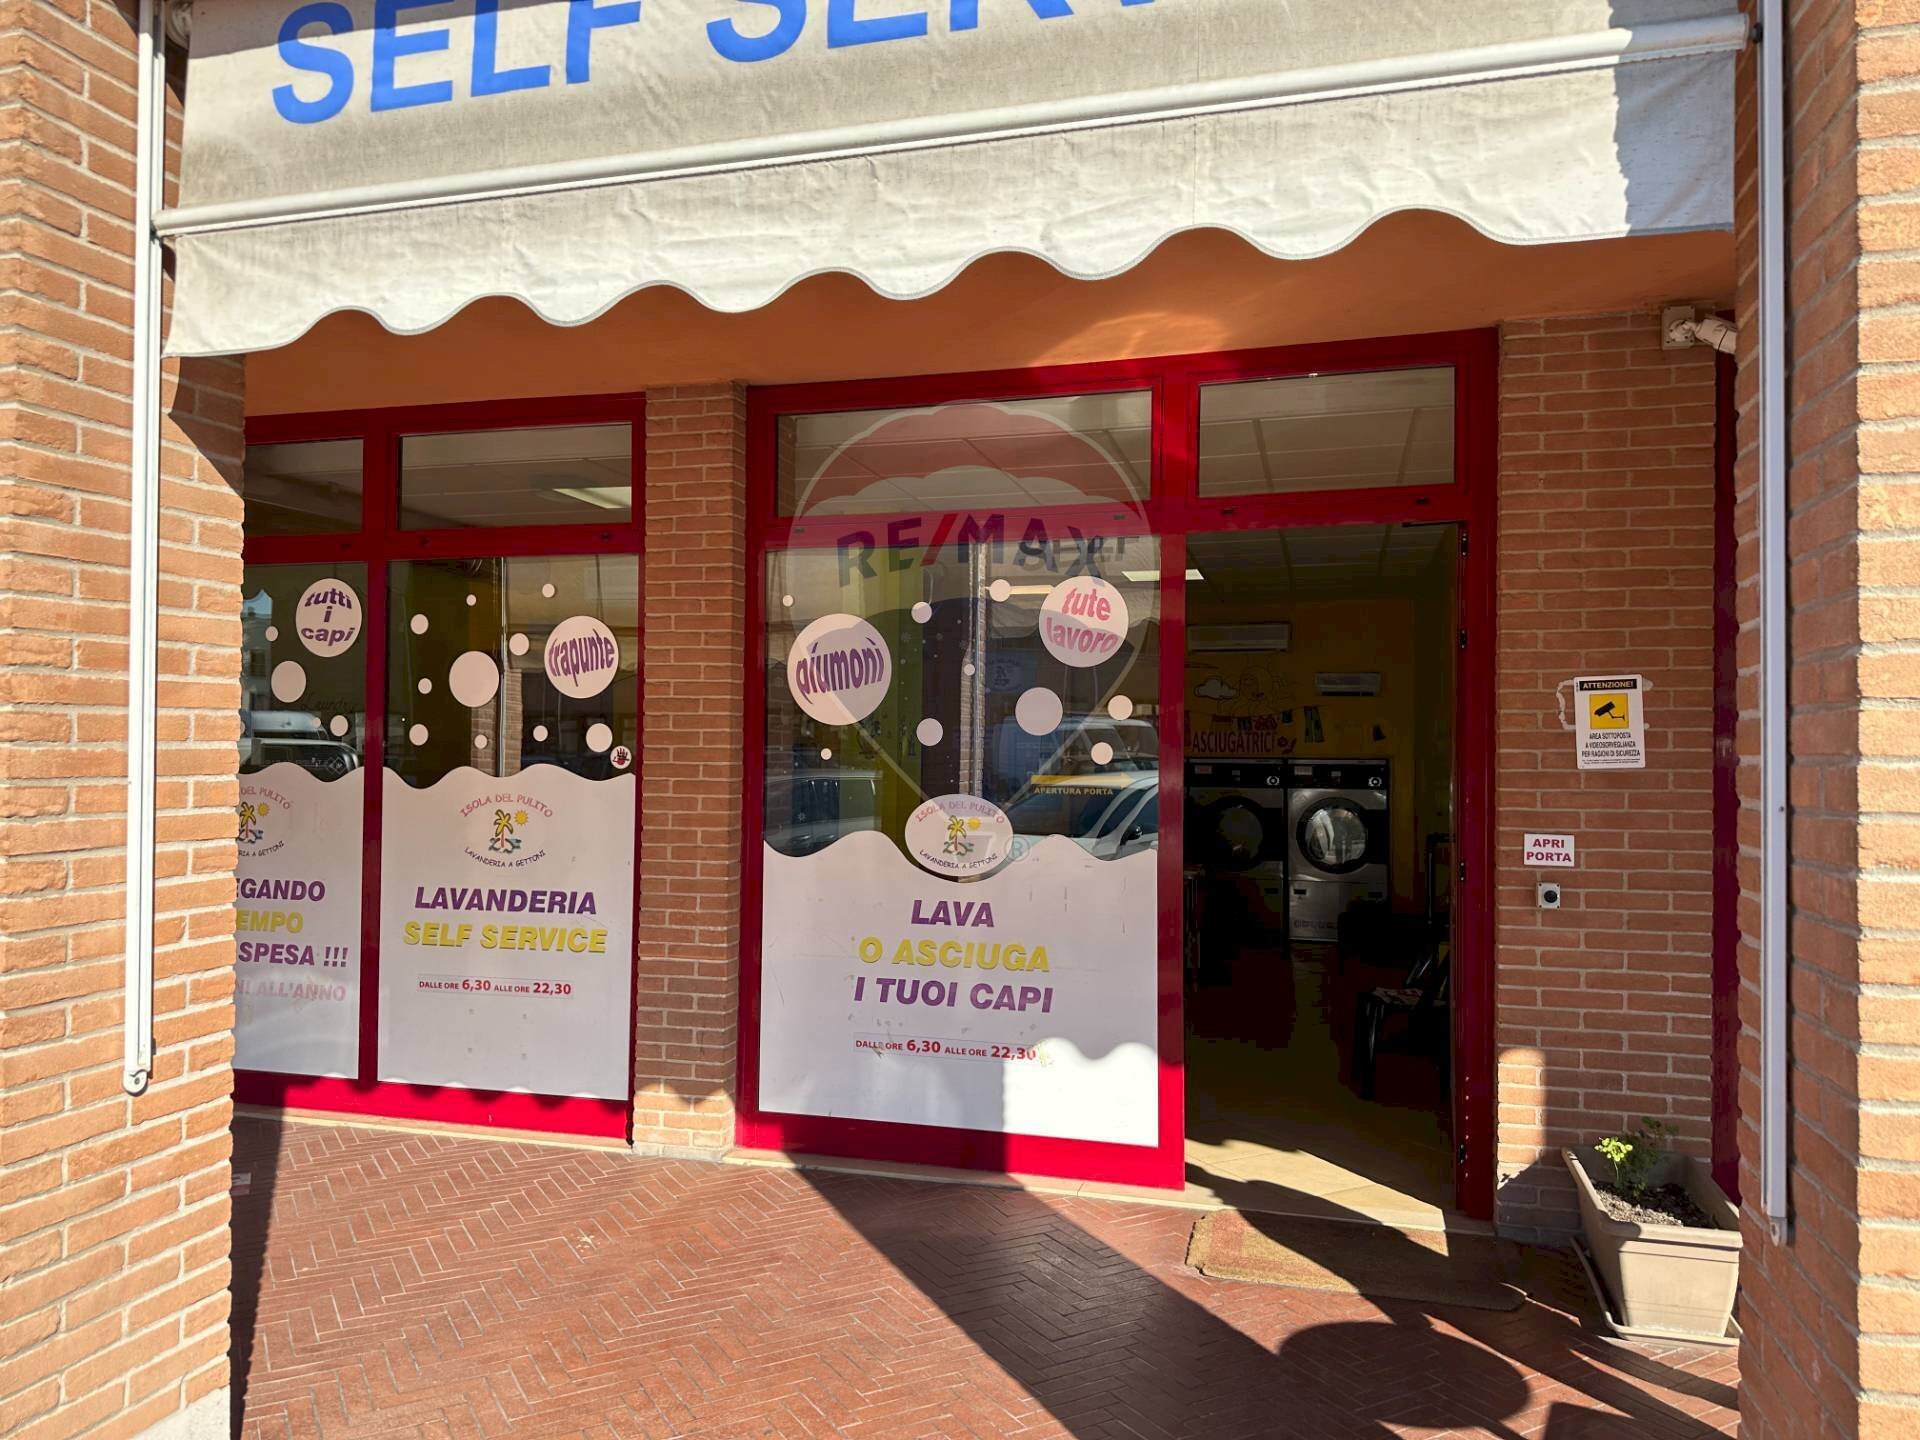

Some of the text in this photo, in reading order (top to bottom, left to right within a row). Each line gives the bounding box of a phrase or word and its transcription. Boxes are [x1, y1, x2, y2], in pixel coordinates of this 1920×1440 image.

[272, 0, 640, 124] SELF
[304, 587, 353, 610] tutti
[1060, 586, 1112, 621] tute
[323, 606, 333, 623] i
[301, 626, 355, 646] capi
[1046, 617, 1120, 654] lavoro
[548, 628, 615, 688] trapunte
[795, 636, 886, 704] piumoni
[1582, 680, 1635, 690] ATTENZIONE!
[1589, 732, 1602, 740] AREA
[259, 787, 290, 810] PULITO
[1033, 787, 1114, 796] APERTURA PORTA
[460, 793, 554, 819] ISOLA DEL PULITO
[914, 800, 1005, 824] ISOLA DEL PULITO
[258, 840, 285, 857] GETTONI
[1532, 838, 1565, 849] APRI
[464, 847, 547, 868] LAVANDERIA A GETTONI
[919, 848, 960, 869] LAVANDERIA
[1526, 851, 1572, 863] PORTA
[415, 886, 598, 915] LAVANDERIA
[236, 909, 304, 934] EMPO
[911, 899, 995, 928] LAVA
[402, 921, 609, 954] SELF SERVICE
[238, 941, 349, 968] SPESA !!!
[858, 937, 1050, 973] O ASCIUGA
[419, 981, 443, 989] DALLE
[444, 982, 459, 990] ORE
[462, 979, 491, 991] 6,30
[514, 985, 530, 993] ORE
[533, 982, 572, 996] 22,30
[853, 976, 1054, 1014] I TUOI CAPI
[885, 1041, 903, 1052] ORE
[906, 1039, 941, 1055] 6,30
[944, 1046, 967, 1056] ALLE
[968, 1047, 987, 1057] ORE
[990, 1045, 1037, 1061] 22,30
